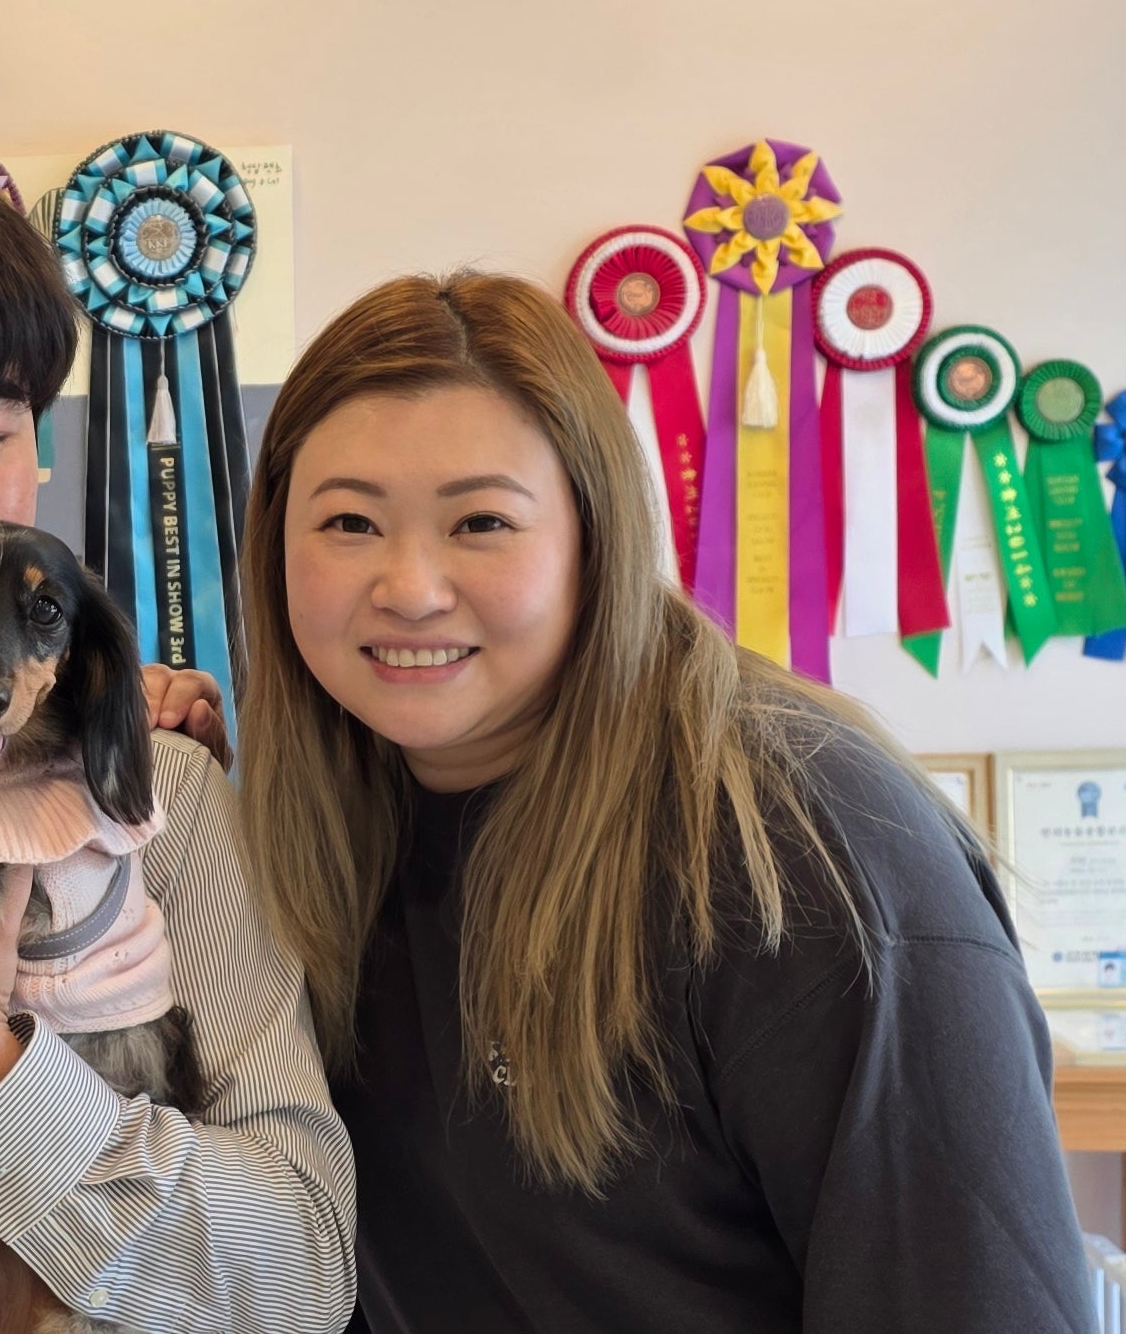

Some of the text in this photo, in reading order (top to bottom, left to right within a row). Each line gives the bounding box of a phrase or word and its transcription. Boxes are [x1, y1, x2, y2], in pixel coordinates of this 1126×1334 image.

[160, 457, 187, 664] PUPPY BEST IN SHOW 3rd
